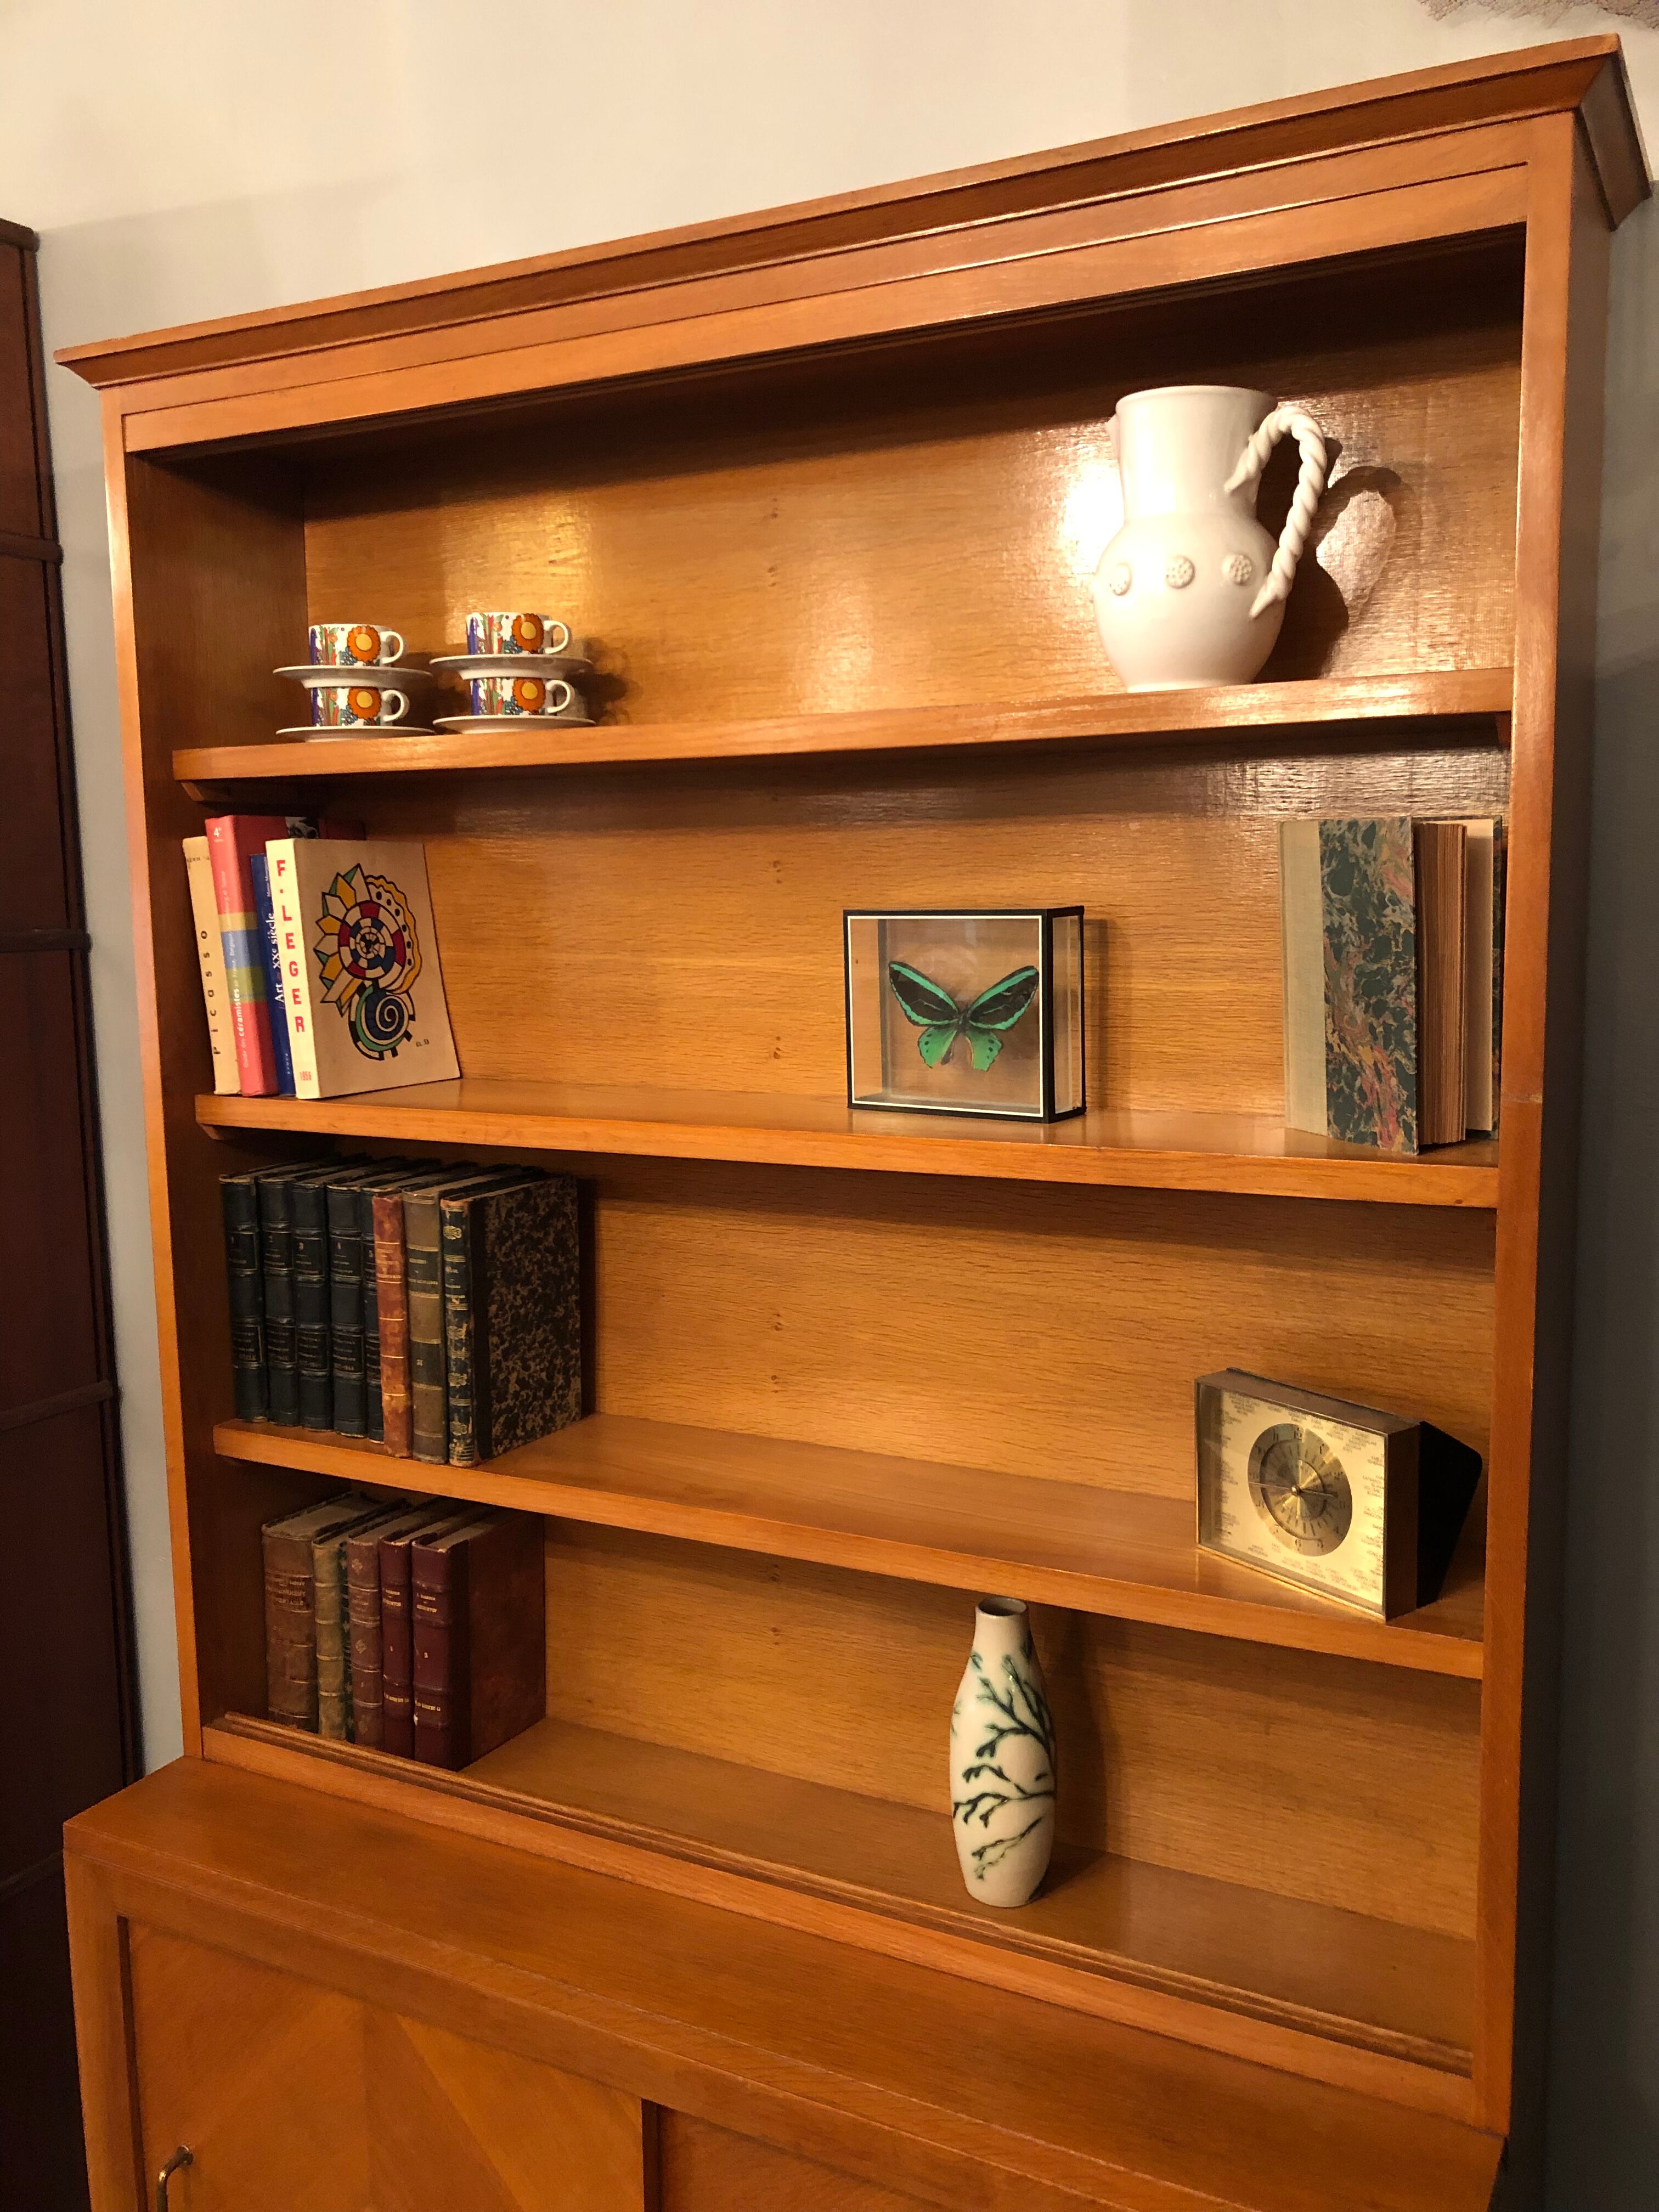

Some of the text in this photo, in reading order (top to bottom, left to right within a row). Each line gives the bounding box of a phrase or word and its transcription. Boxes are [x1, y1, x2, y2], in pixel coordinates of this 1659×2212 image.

[201, 930, 221, 1055] Picasso
[234, 988, 245, 1036] céramistes
[282, 905, 305, 1032] LEGER
